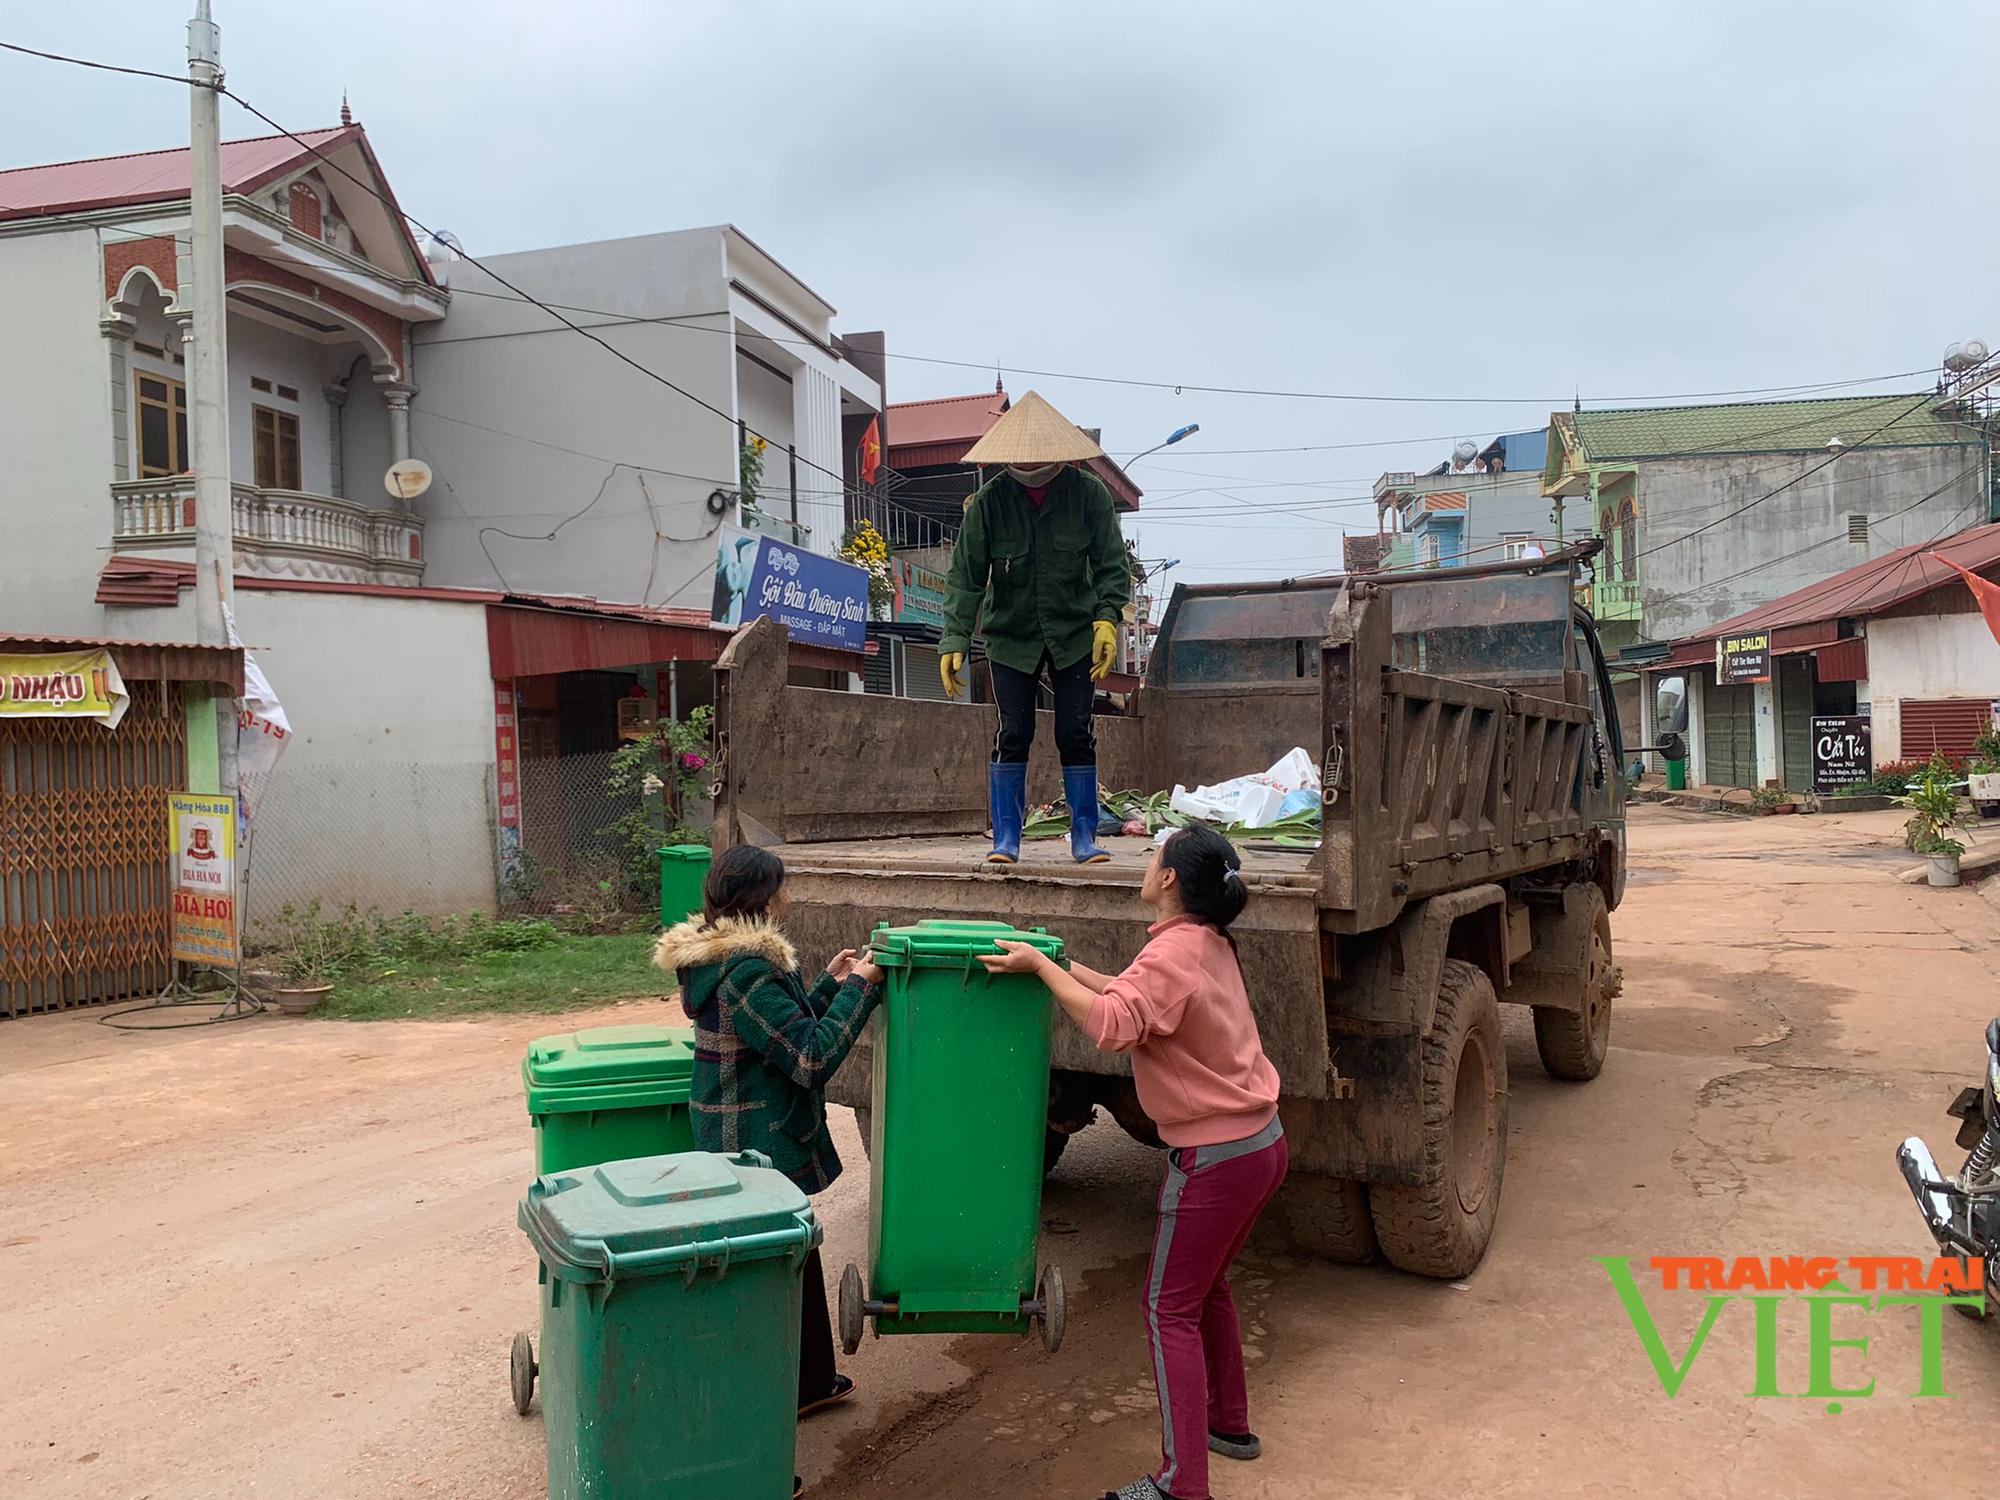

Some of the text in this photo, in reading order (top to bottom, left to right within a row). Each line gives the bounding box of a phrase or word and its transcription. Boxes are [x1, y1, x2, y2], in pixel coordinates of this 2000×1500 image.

[760, 575, 864, 623] Gội Đầu Dưỡng Sinh
[780, 614, 812, 631] MASSAGE
[1741, 636, 1768, 652] SALON
[11, 671, 84, 706] NHẬU
[1817, 734, 1865, 760] Cắt Tóc
[213, 803, 230, 815] 888
[174, 894, 201, 916] BIA
